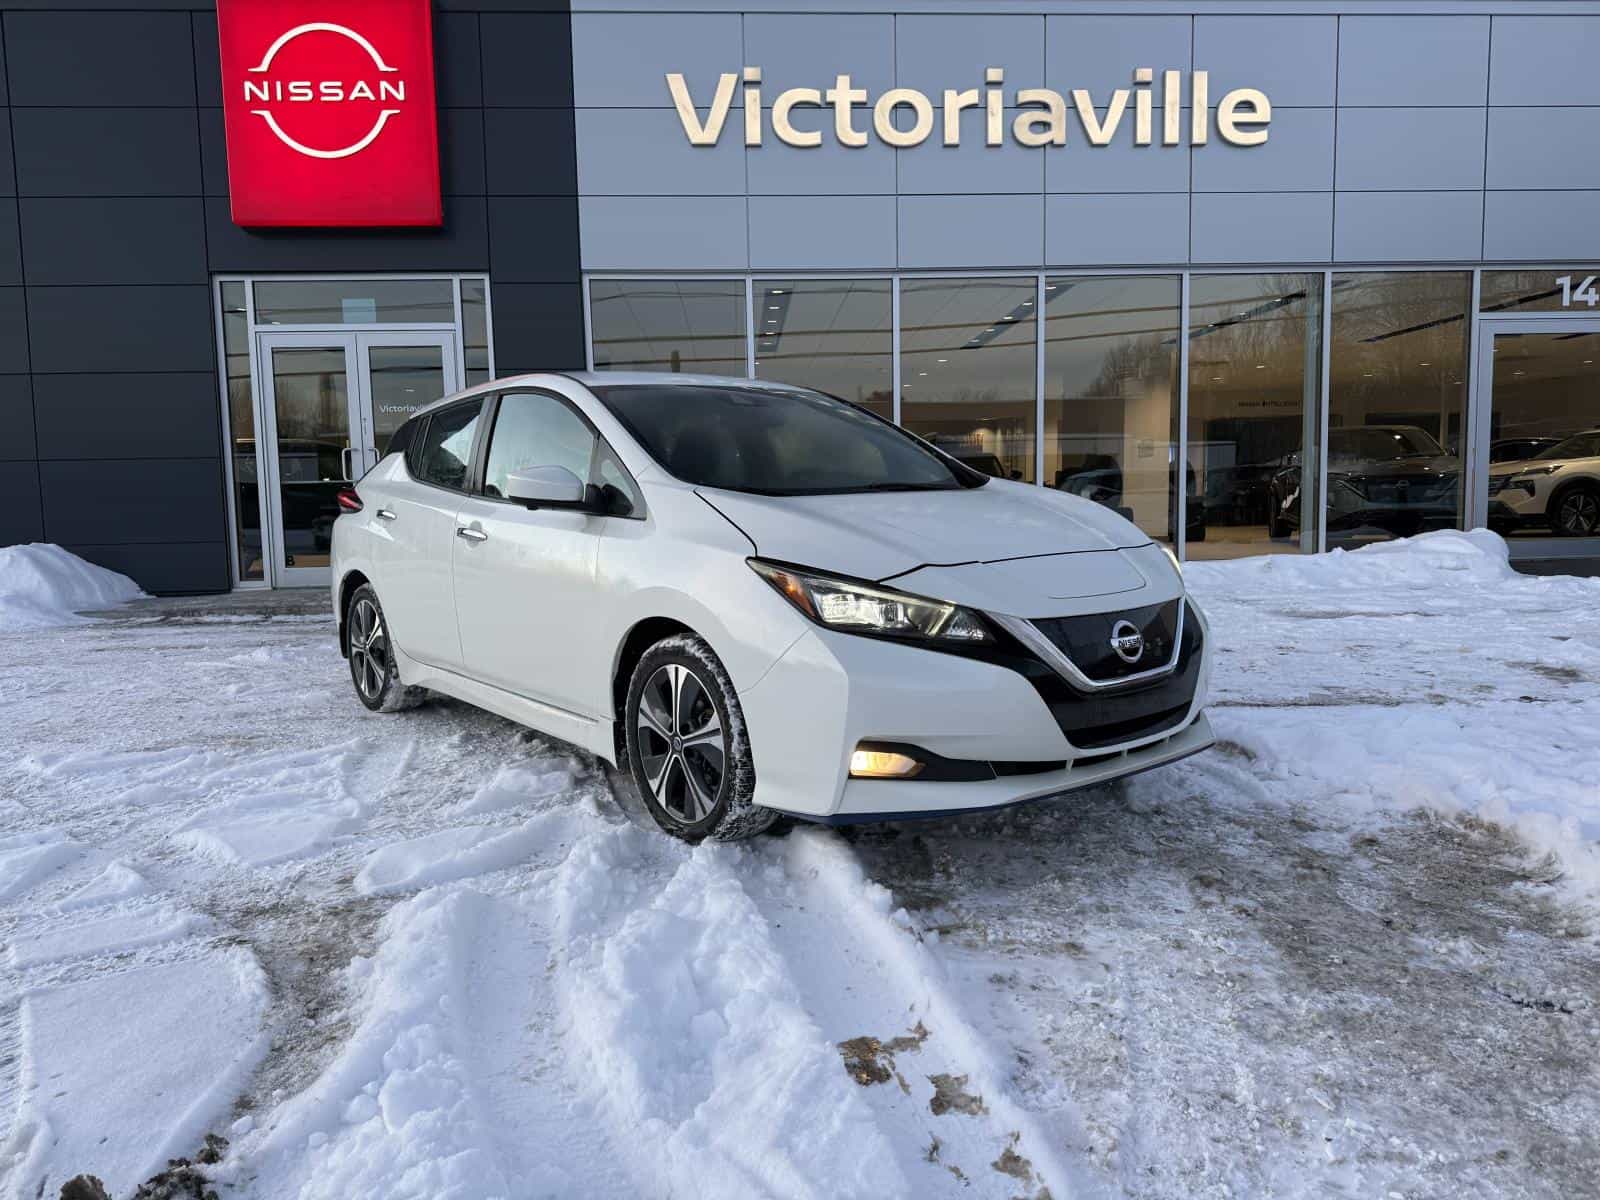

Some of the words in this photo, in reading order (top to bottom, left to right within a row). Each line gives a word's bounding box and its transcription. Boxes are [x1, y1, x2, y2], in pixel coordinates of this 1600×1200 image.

[243, 80, 406, 102] NISSAN
[665, 66, 1272, 147] Victoriaville
[1555, 275, 1599, 307] 14
